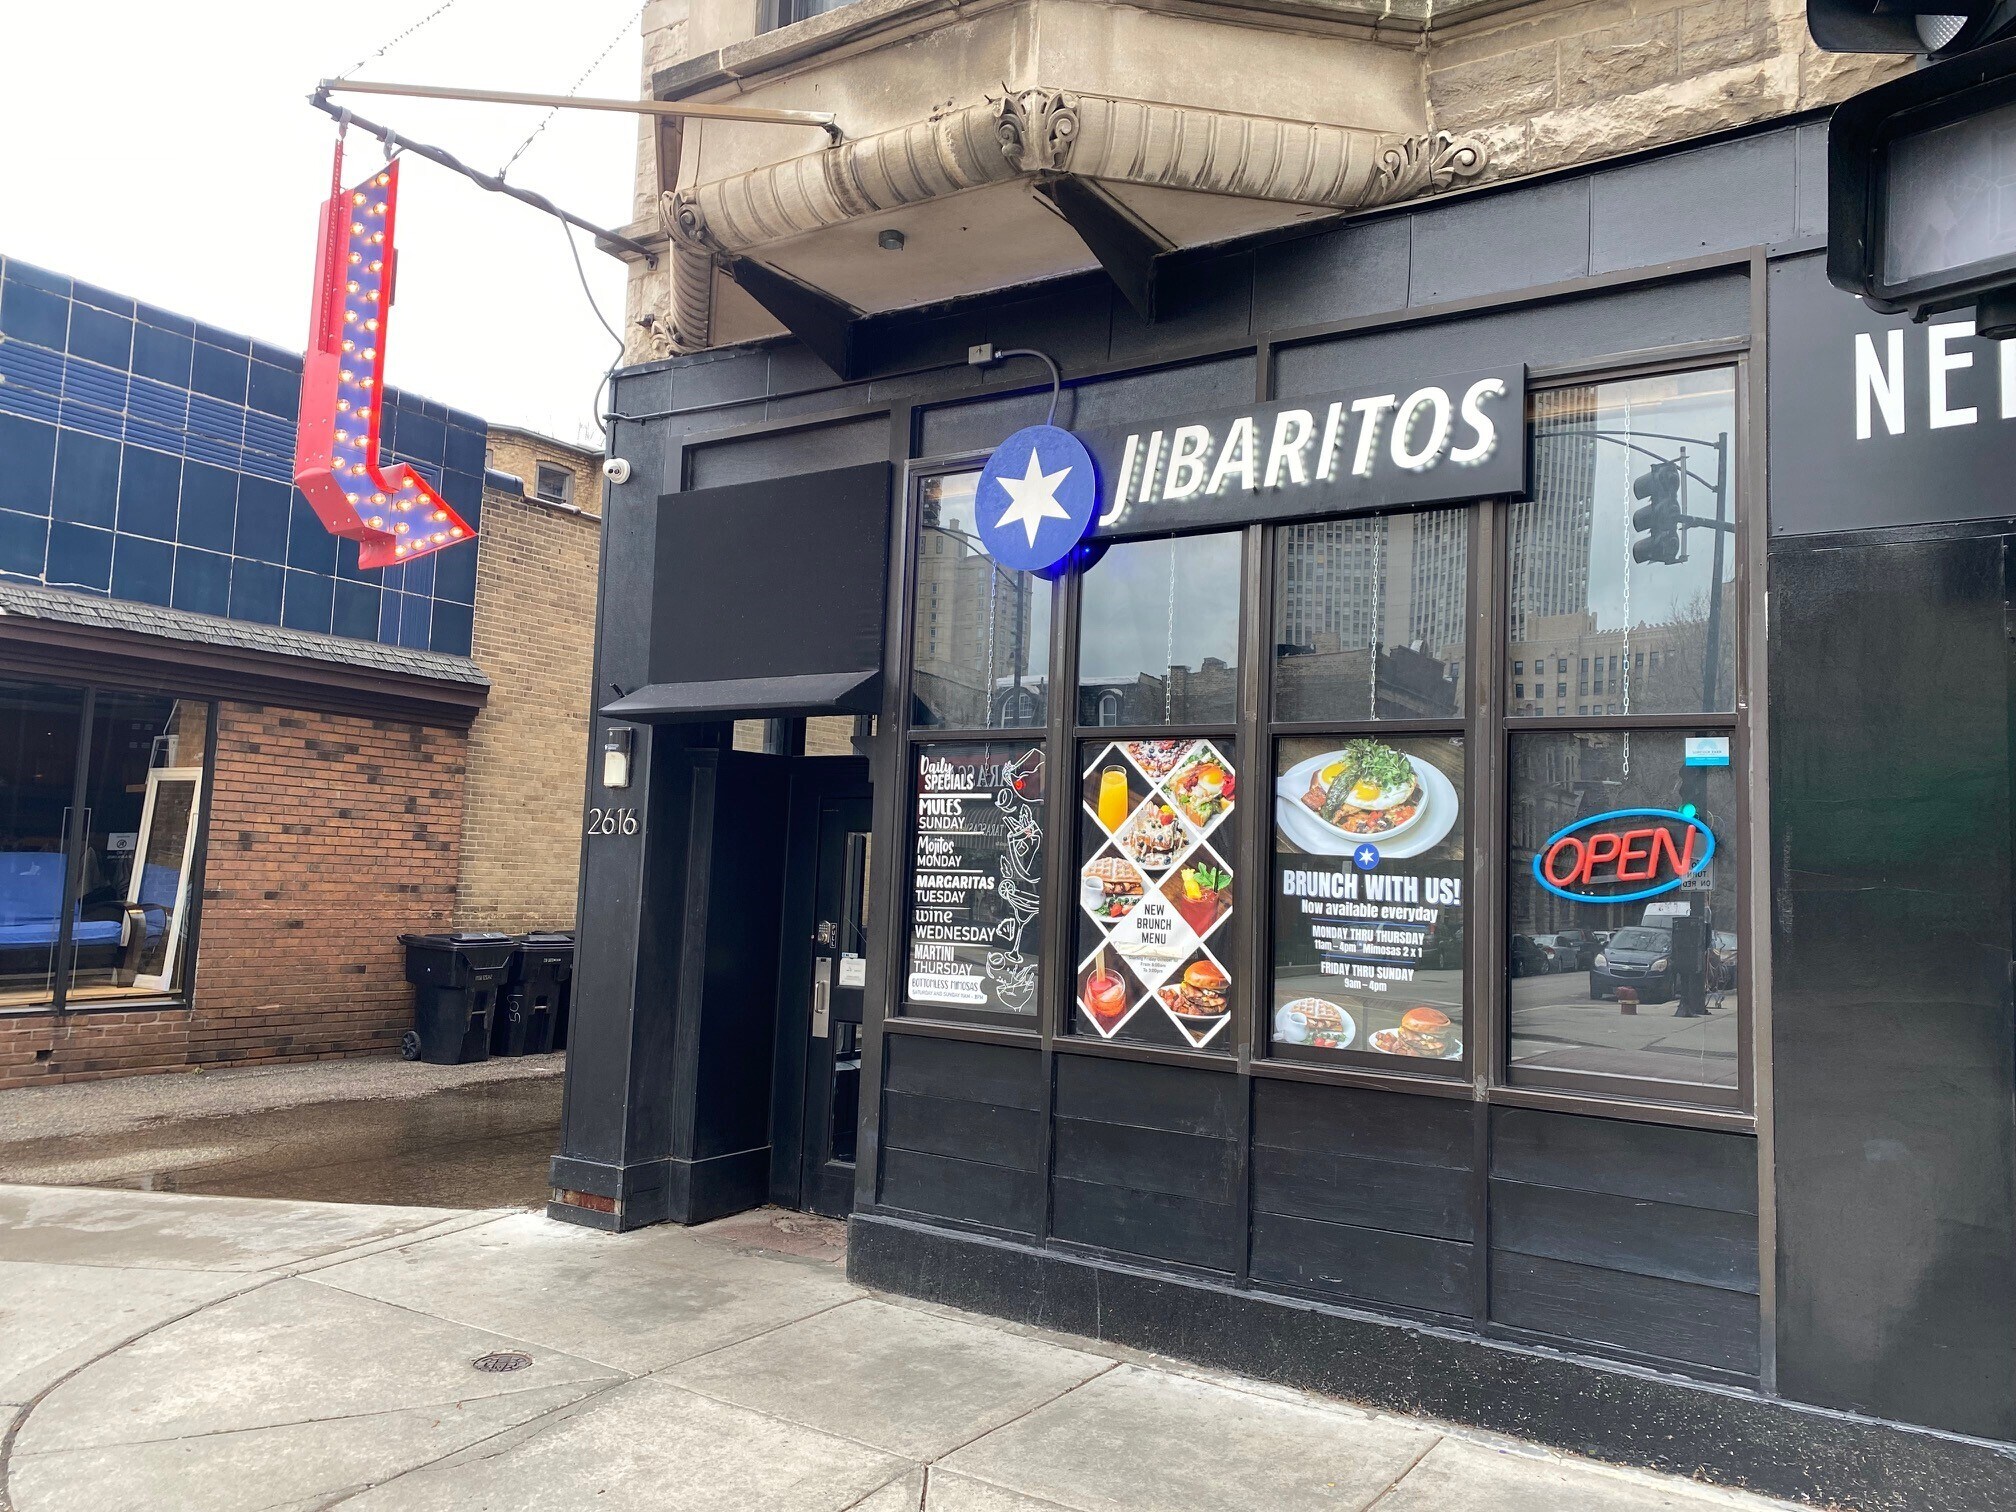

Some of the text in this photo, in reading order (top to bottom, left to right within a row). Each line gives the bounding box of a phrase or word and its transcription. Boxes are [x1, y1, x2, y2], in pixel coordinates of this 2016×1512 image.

[1099, 378, 1506, 527] JIBARITOS
[920, 754, 955, 780] Daily
[924, 773, 975, 790] SPECIALS
[918, 798, 962, 816] MULES
[587, 808, 638, 835] 2616
[918, 816, 966, 830] SUNDAY
[917, 835, 955, 858] Mojitos
[917, 855, 962, 867] MONDAY
[1545, 824, 1697, 887] OPEN
[915, 874, 995, 890] MARGARITAS
[1283, 869, 1463, 906] BRUNCH WITH US!
[915, 890, 966, 903] TUESDAY
[915, 906, 953, 923] wine
[1144, 904, 1165, 916] NEW
[1301, 899, 1439, 923] Now available everyday
[1136, 918, 1172, 930] BRUNCH
[915, 924, 996, 942] WEDNESDAY
[1141, 932, 1167, 944] MENU
[1312, 924, 1425, 946] MONDAY THRU THURSDAY
[914, 944, 955, 961] MARTINI
[1314, 939, 1332, 950] 11am
[1339, 941, 1357, 953] 4pm
[1362, 943, 1401, 956] Mimosas
[1402, 946, 1409, 957] 2
[1418, 947, 1423, 958] 1
[913, 961, 973, 976] THURSDAY
[1320, 961, 1415, 981] FRIDAY THRU SUNDAY
[911, 977, 978, 992] BOTTOMLESS MIMOSAS
[1344, 978, 1362, 989] 9am
[1369, 980, 1387, 992] 4pm
